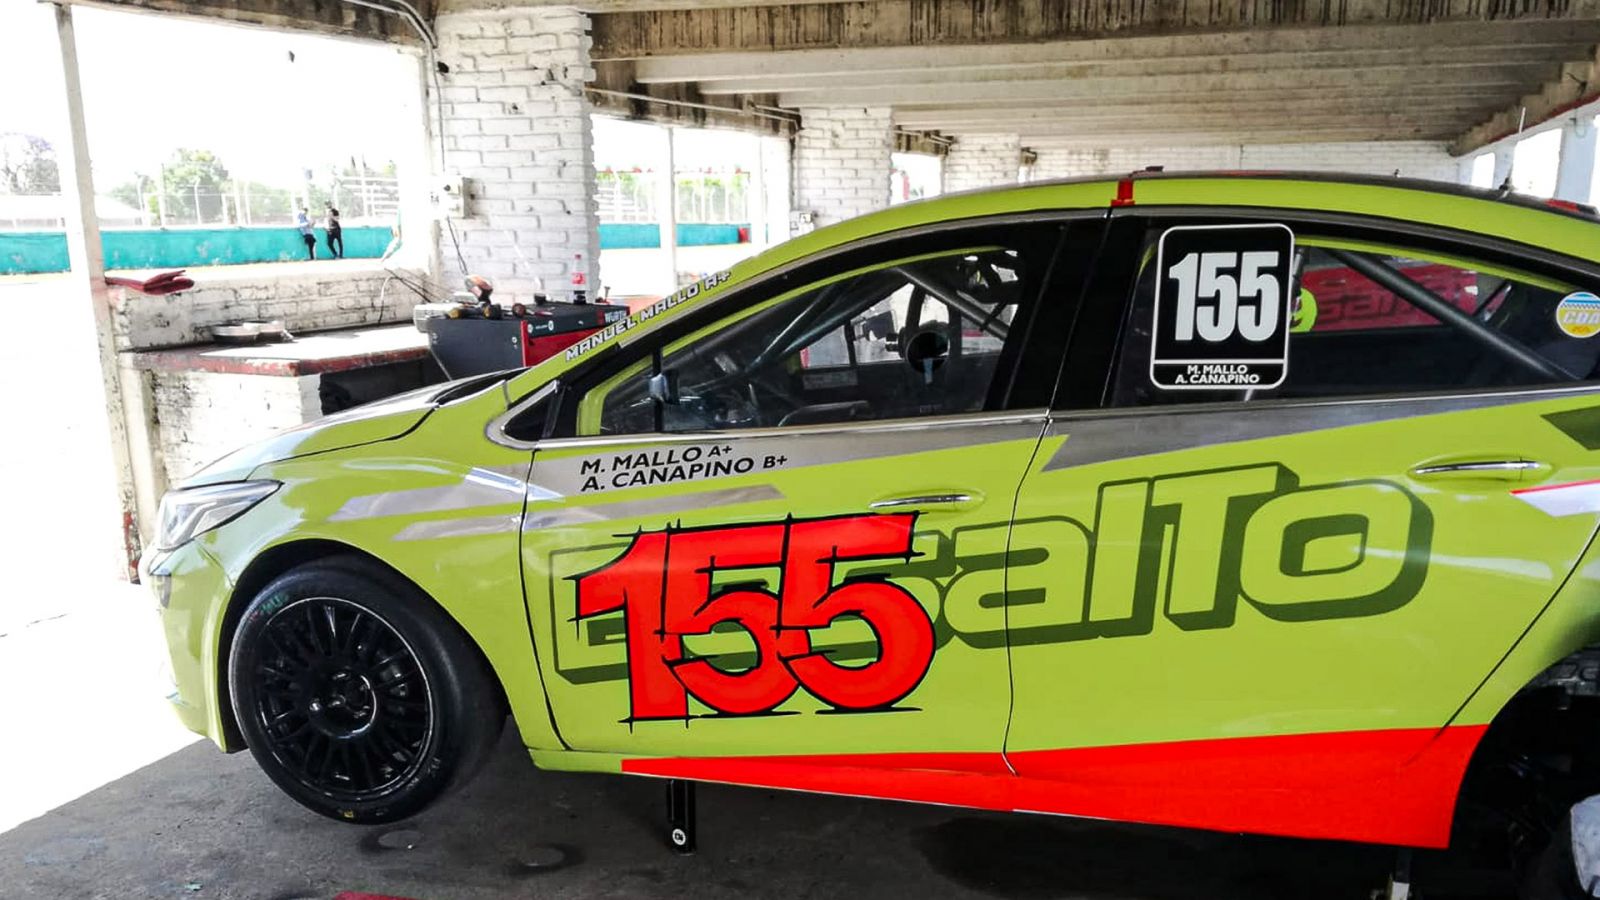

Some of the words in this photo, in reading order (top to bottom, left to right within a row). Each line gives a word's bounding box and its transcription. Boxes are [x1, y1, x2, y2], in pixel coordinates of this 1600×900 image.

[1168, 251, 1280, 342] 155
[566, 315, 638, 362] MANUEL
[640, 283, 700, 322] MALLO
[705, 271, 731, 290] A+
[1175, 374, 1188, 384] A.
[1189, 374, 1260, 384] CANAPINO
[1187, 364, 1202, 375] M.
[1203, 364, 1248, 375] MALLO
[580, 460, 605, 475] M.
[612, 446, 701, 471] MALLO
[708, 445, 732, 457] A+
[581, 476, 605, 492] A.
[612, 457, 754, 488] CANAPINO
[763, 455, 788, 469] B+
[568, 511, 937, 726] 155
